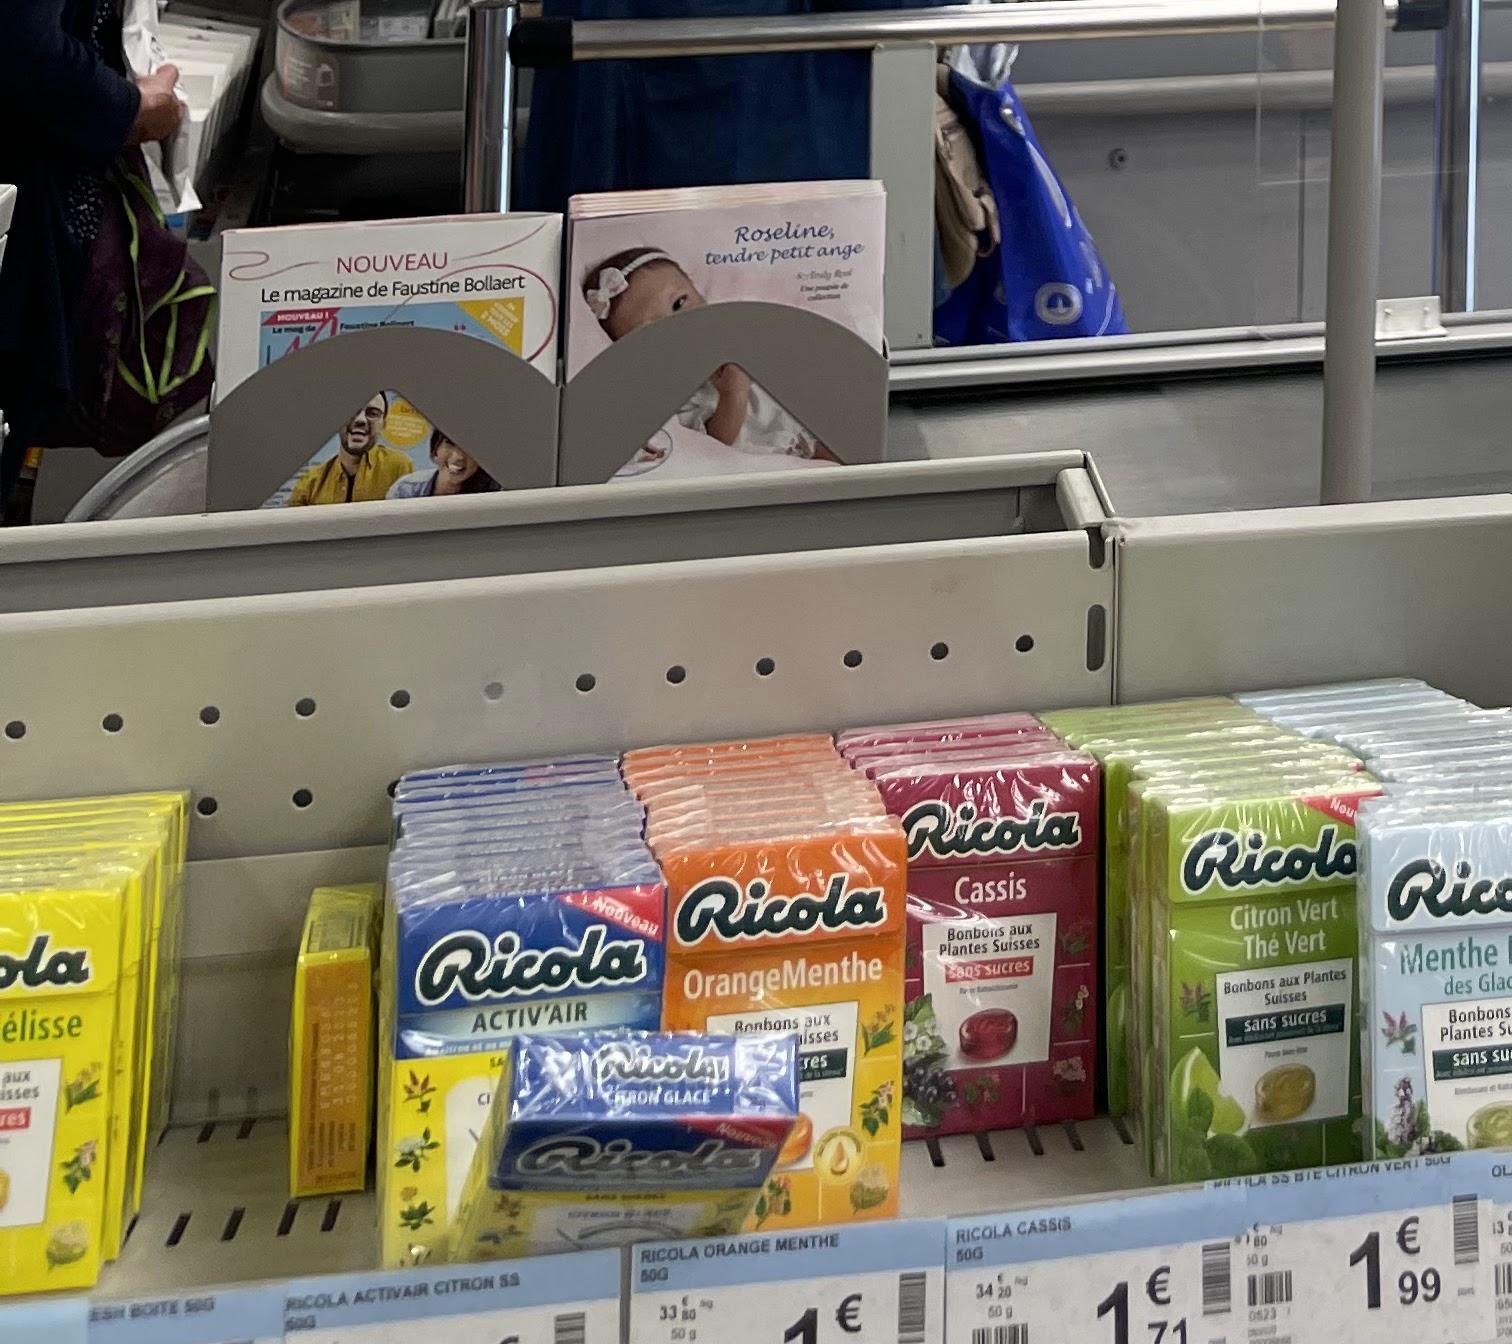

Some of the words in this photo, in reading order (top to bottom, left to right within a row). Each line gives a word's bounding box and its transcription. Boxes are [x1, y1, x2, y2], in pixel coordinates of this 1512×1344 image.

[734, 221, 836, 245] Roseline,
[336, 252, 448, 274] NOUVEAU
[705, 247, 768, 266] tendre
[770, 245, 815, 265] petit
[816, 243, 866, 261] ange
[261, 288, 280, 303] Le
[284, 283, 364, 305] magazine
[367, 280, 388, 298] de
[392, 278, 460, 297] Faustine
[464, 275, 526, 292] Bollaert
[903, 800, 1080, 858] Ricola
[954, 871, 1027, 905] Cassis
[593, 896, 659, 936] Nouveau
[677, 876, 886, 945] Ricola
[1230, 904, 1292, 930] Citron
[1297, 897, 1338, 922] Vert
[939, 942, 988, 956] Plantes
[992, 938, 1040, 953] Suisses
[947, 925, 1004, 941] Bonbons
[1010, 924, 1032, 936] aux
[1243, 932, 1279, 960] Thé
[1285, 928, 1326, 955] Vert
[416, 925, 646, 1005] Ricola
[982, 961, 1030, 975] sucres
[1400, 936, 1498, 975] Menthe
[684, 952, 882, 1001] OrangeMenthe
[1224, 977, 1275, 994] Bonbons
[1279, 975, 1299, 987] aux
[1304, 969, 1347, 984] Plantes
[1444, 976, 1473, 995] des
[1265, 990, 1307, 1005] Suisses
[472, 1001, 589, 1033] ACTIV'AIR
[805, 1014, 831, 1028] aux
[1244, 1016, 1277, 1032] sans
[1282, 1010, 1327, 1028] sucres
[1449, 1005, 1511, 1023] Bonbons
[1440, 1021, 1494, 1041] Plantes
[1452, 1049, 1488, 1066] sans
[3, 1070, 31, 1084] aux
[956, 1226, 1012, 1244] RICOLA
[1017, 1216, 1072, 1235] CASSIS
[1397, 1216, 1421, 1254] €
[640, 1242, 699, 1263] RICOLA
[704, 1238, 770, 1258] ORANGE
[775, 1233, 839, 1252] MENTHE
[433, 1275, 494, 1294] CITRON
[1349, 1231, 1381, 1309] 1
[1399, 1267, 1441, 1305] 99
[836, 1294, 863, 1332] €
[1097, 1281, 1128, 1344] 1
[1146, 1265, 1171, 1305] €
